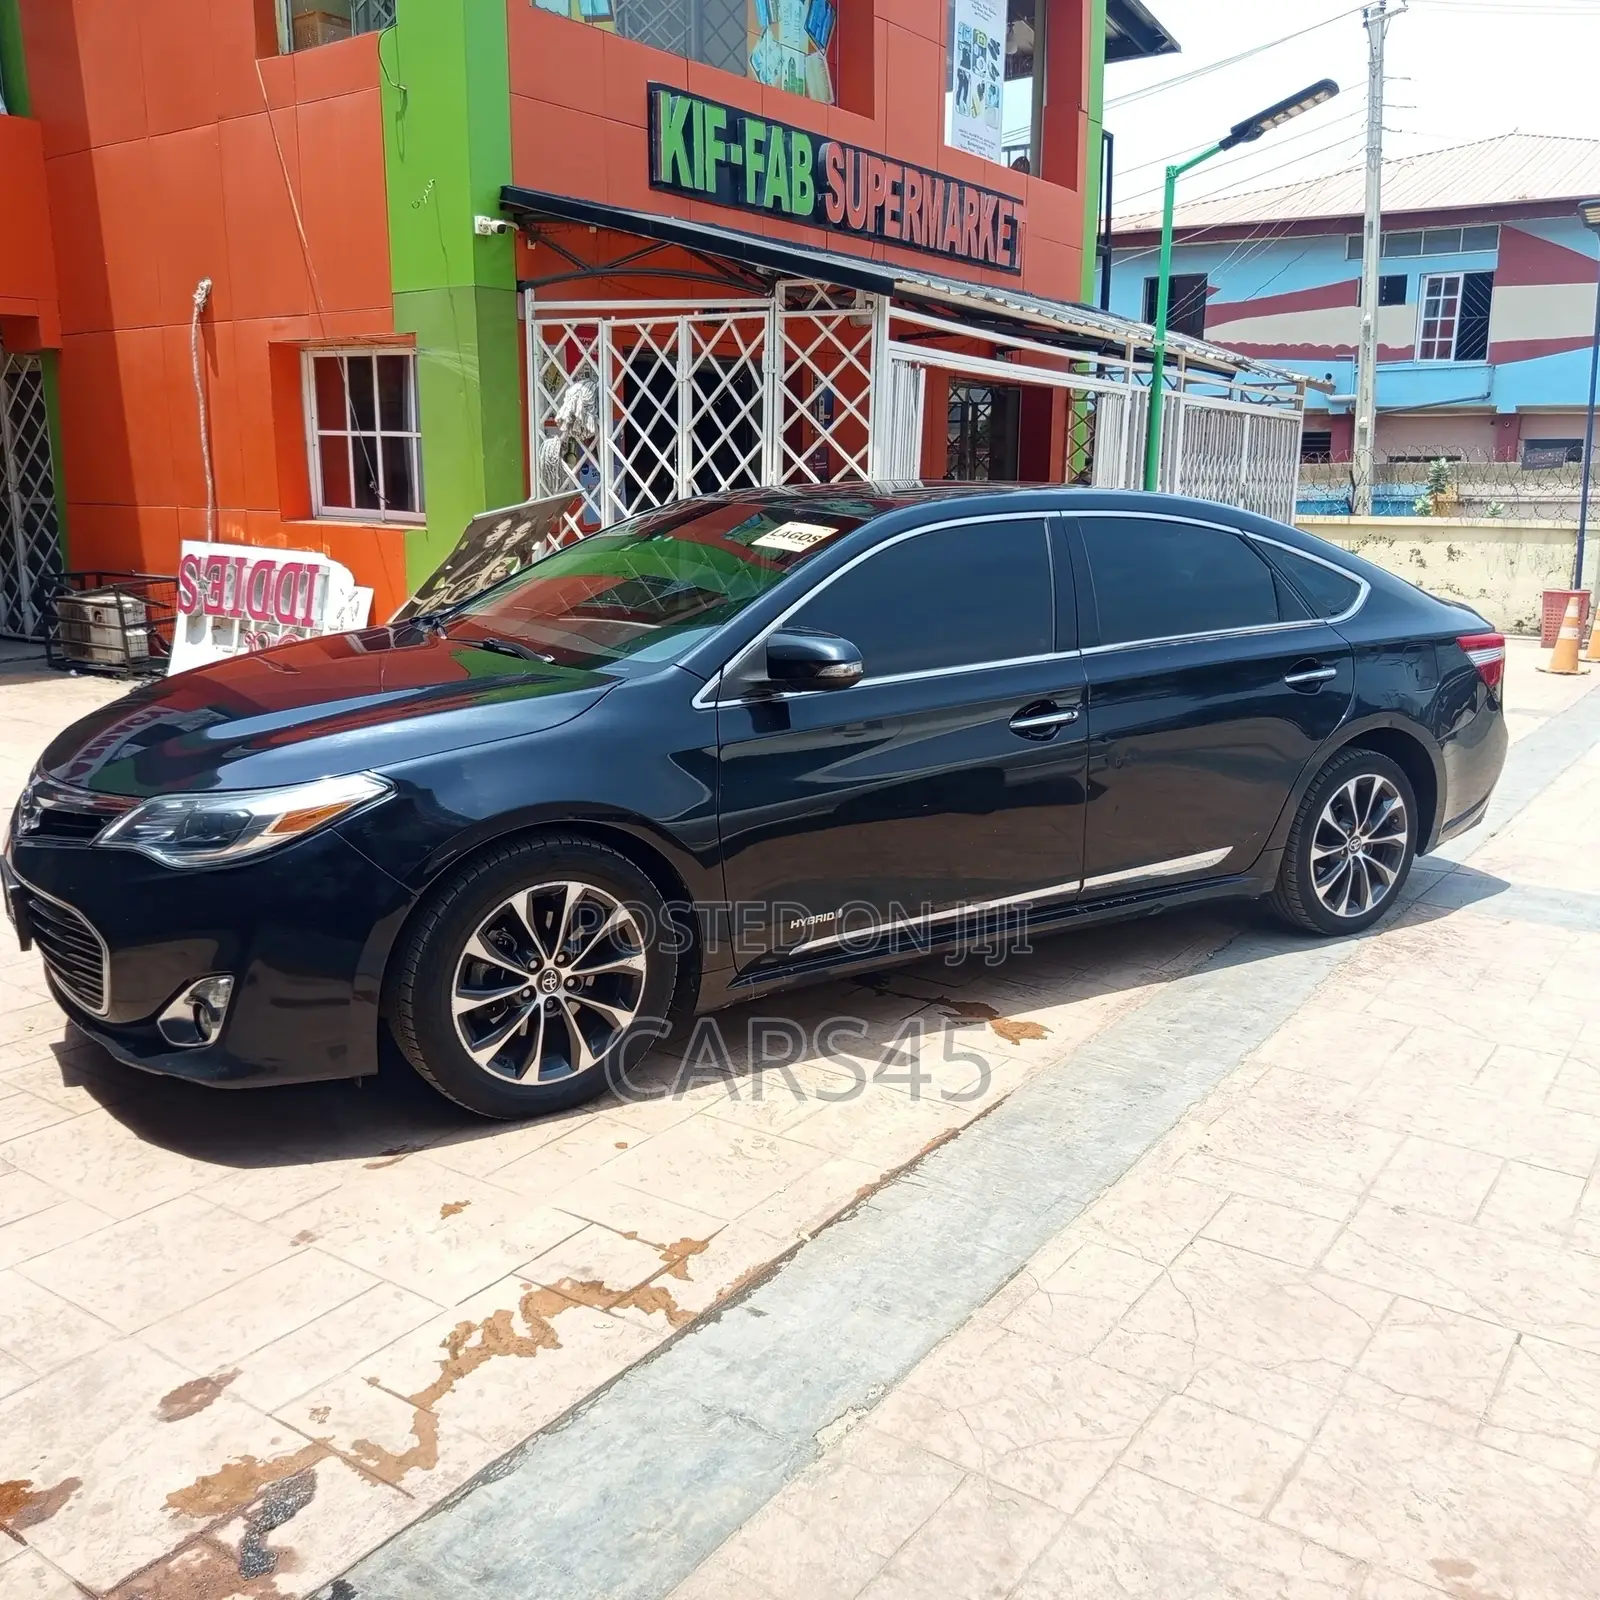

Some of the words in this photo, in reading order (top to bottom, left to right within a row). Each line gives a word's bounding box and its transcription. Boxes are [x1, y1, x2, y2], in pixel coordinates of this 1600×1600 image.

[654, 91, 814, 216] KIF-FAB
[823, 141, 1026, 270] SUPERMARKET
[769, 528, 823, 543] LAGOS
[790, 911, 836, 929] HYBRID
